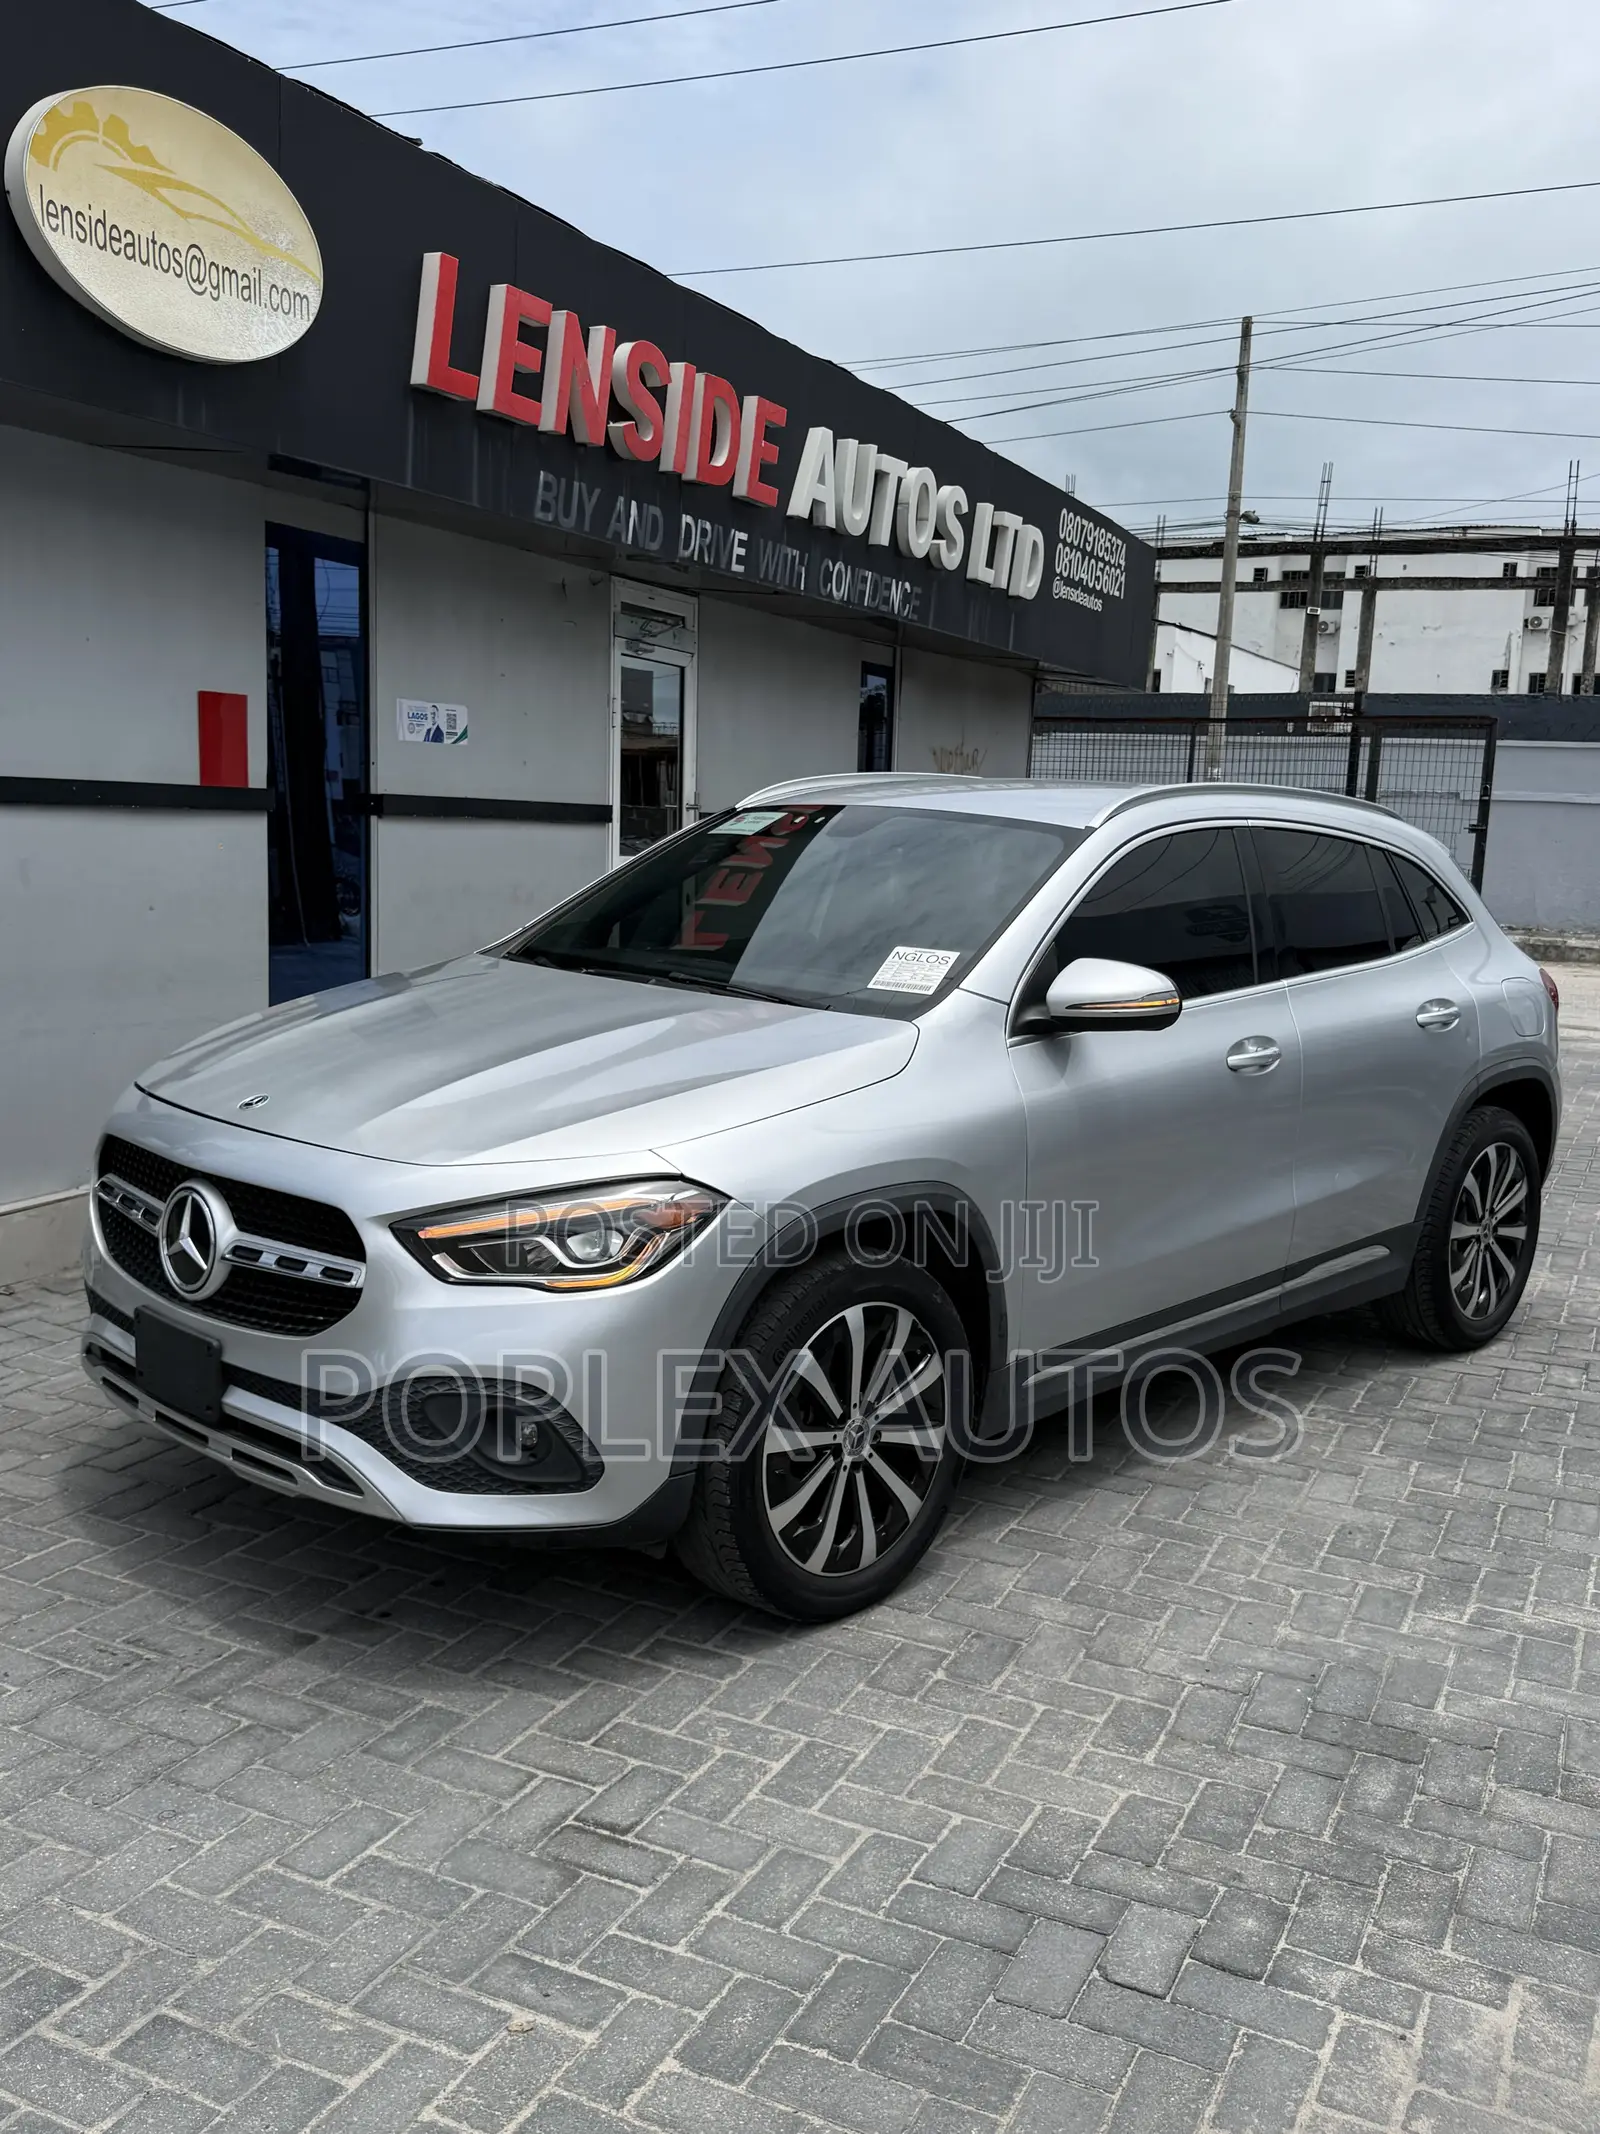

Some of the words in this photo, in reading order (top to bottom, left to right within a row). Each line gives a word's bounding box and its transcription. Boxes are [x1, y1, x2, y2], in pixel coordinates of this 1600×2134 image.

[39, 184, 311, 322] lensideautos@gmail.com
[410, 252, 787, 508] LENSIDE
[786, 426, 969, 571] AUTOS
[966, 502, 1045, 600] LTD
[533, 470, 601, 533] BUY
[606, 495, 664, 551] AND
[678, 513, 748, 574] DRIVE
[759, 537, 809, 592] WITH
[818, 558, 922, 621] CONFIDENCE
[1059, 507, 1126, 571] 08079185374
[1052, 575, 1103, 613] @lensideautos
[1055, 542, 1126, 600] 08104056021
[407, 711, 428, 721] LAGOS
[891, 951, 951, 965] NGLOS
